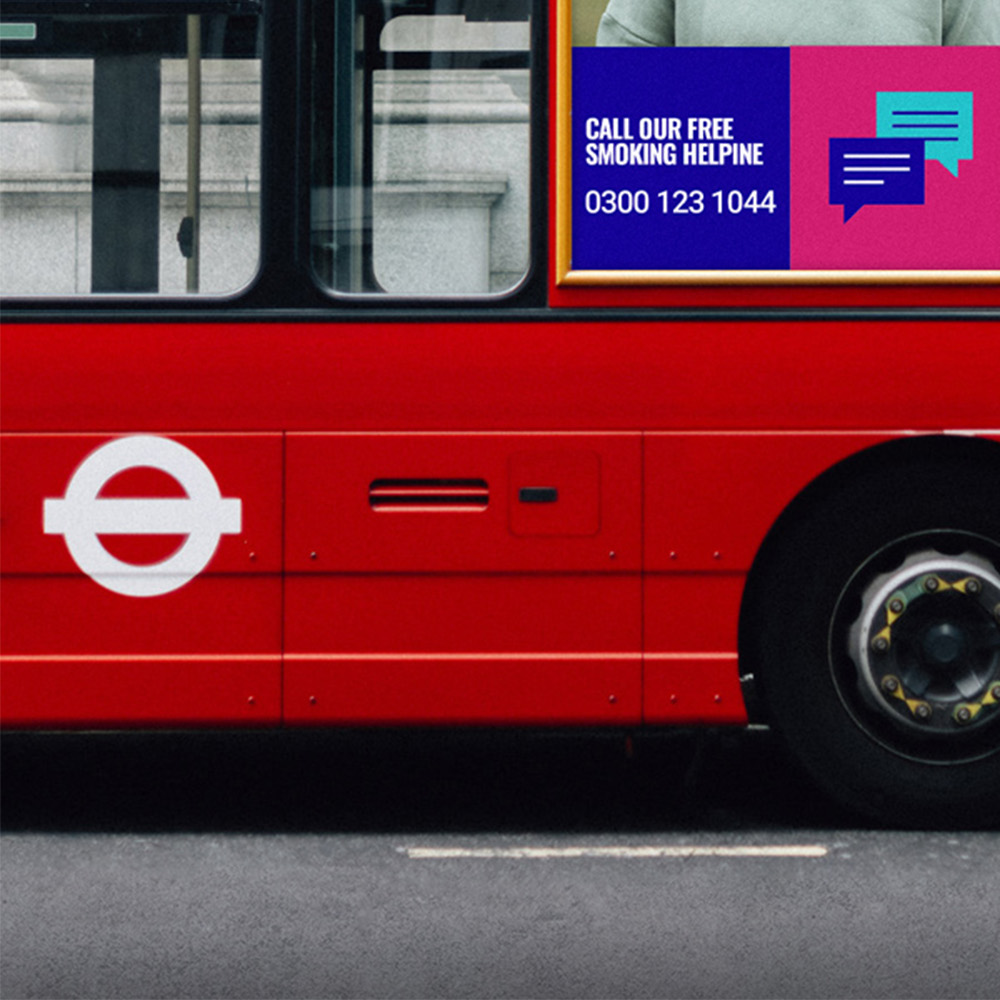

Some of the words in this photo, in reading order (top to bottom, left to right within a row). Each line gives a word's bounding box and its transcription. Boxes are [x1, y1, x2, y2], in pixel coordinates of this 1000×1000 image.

[585, 117, 634, 141] CALL
[639, 117, 682, 141] OUR
[687, 117, 734, 140] FREE
[585, 142, 677, 166] SMOKING
[682, 142, 764, 166] HELPINE
[585, 189, 650, 214] 0300
[657, 189, 705, 214] 123
[711, 189, 777, 214] 1044
